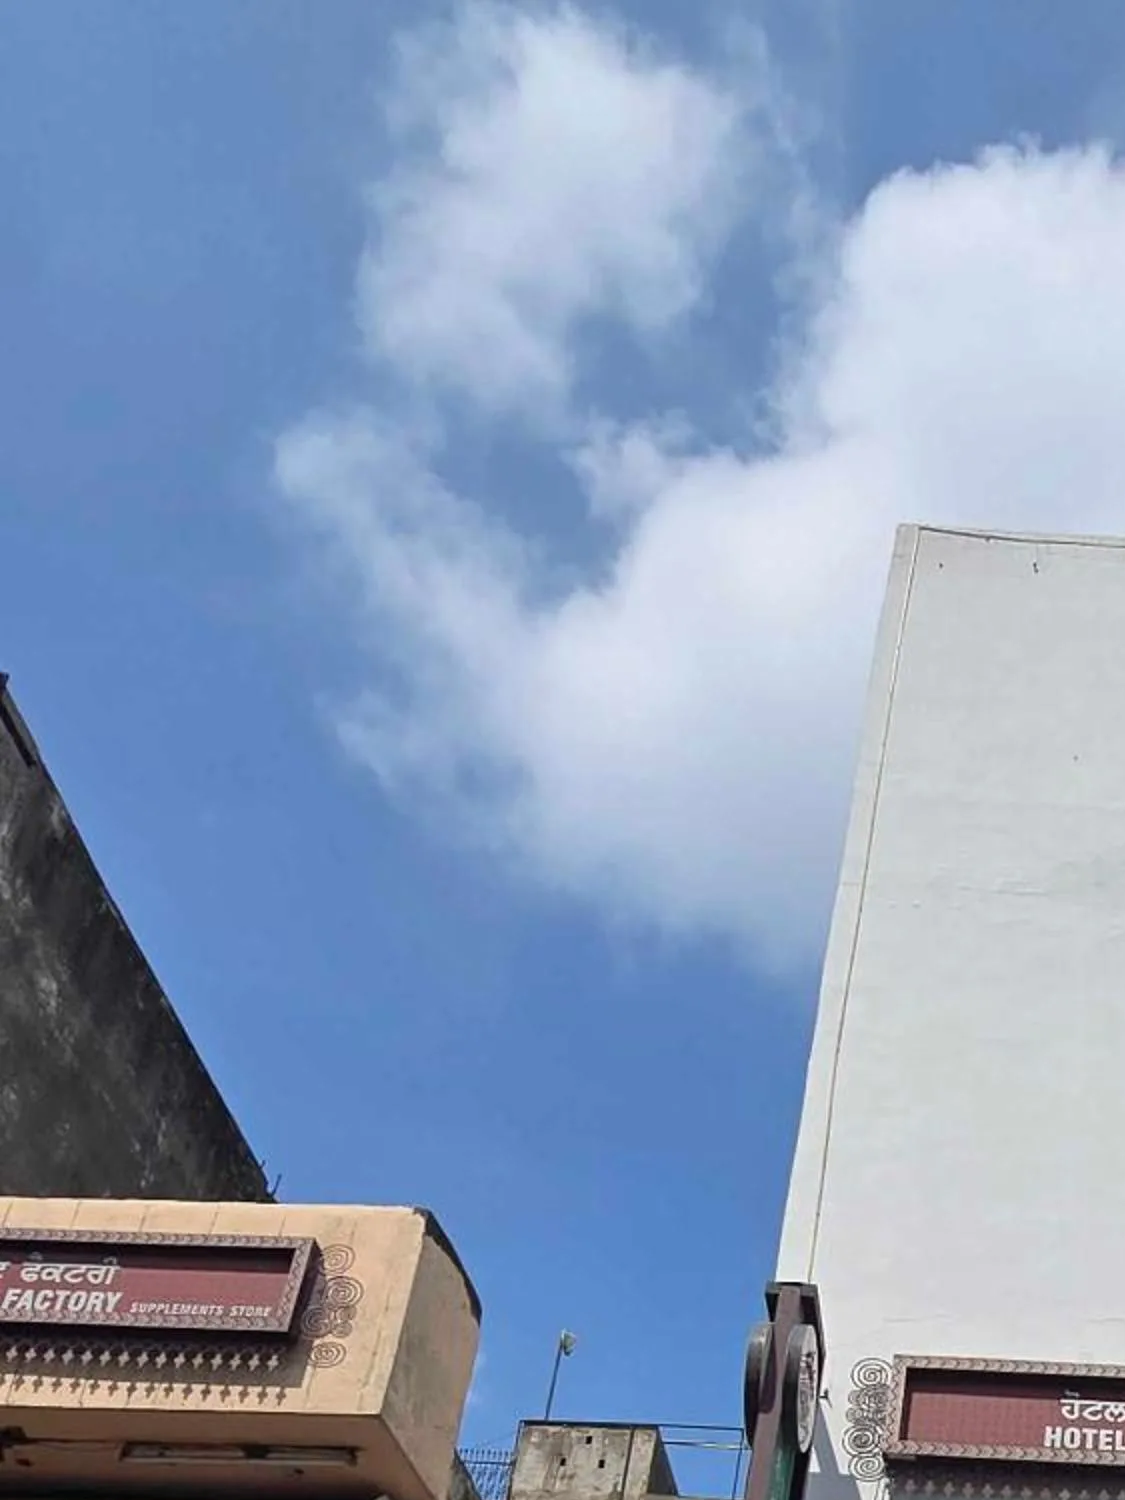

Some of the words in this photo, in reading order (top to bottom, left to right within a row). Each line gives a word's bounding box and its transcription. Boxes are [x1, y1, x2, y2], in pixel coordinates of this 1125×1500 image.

[2, 1288, 123, 1314] FACTORY
[130, 1302, 223, 1316] SUPPLEMENTS
[229, 1307, 272, 1318] STORE
